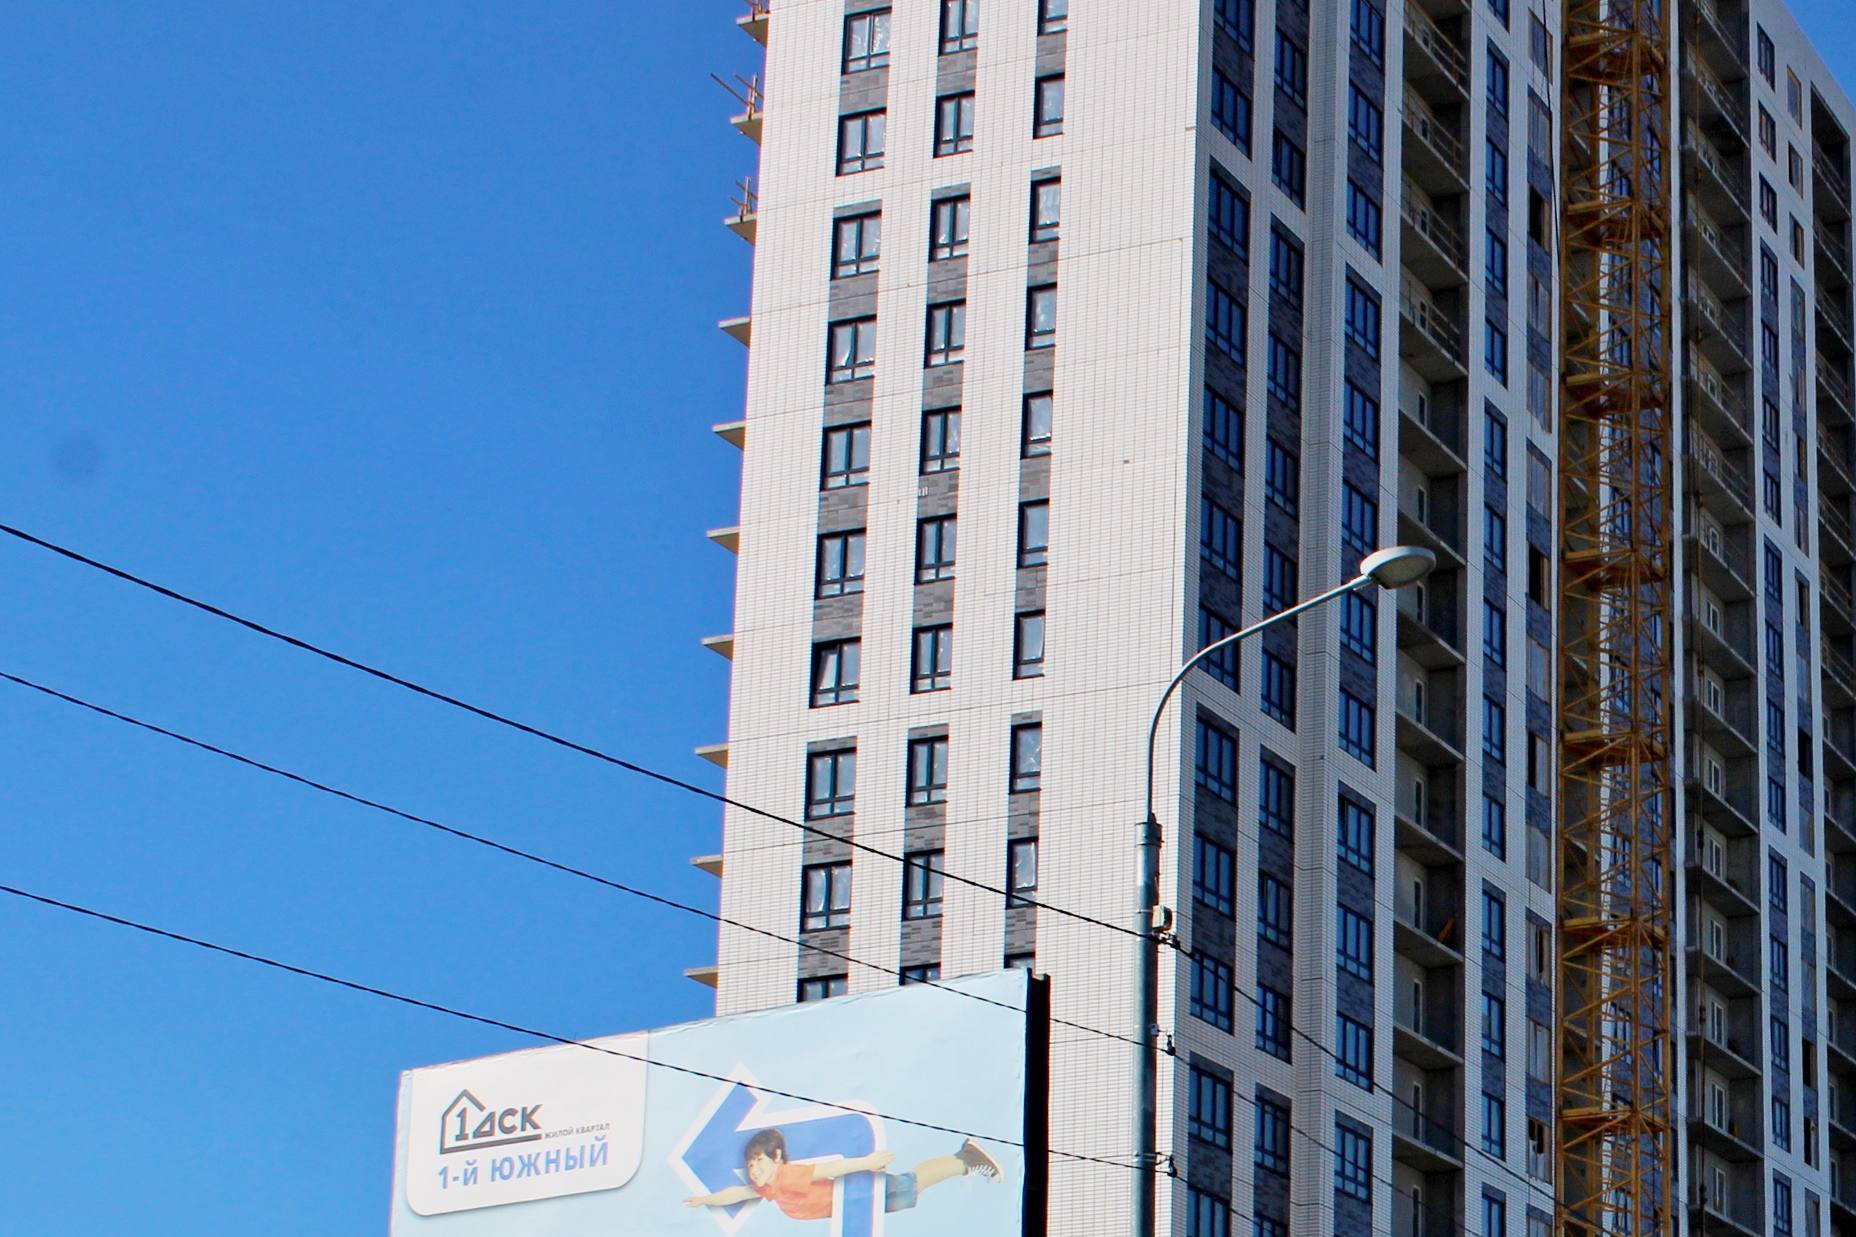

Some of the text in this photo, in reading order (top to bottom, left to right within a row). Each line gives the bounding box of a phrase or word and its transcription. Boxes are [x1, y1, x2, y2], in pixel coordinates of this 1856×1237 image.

[544, 1122, 611, 1139] ЖИЛОЙ КВАРТАЛ
[489, 1134, 609, 1182] ЮЖНЫЙ
